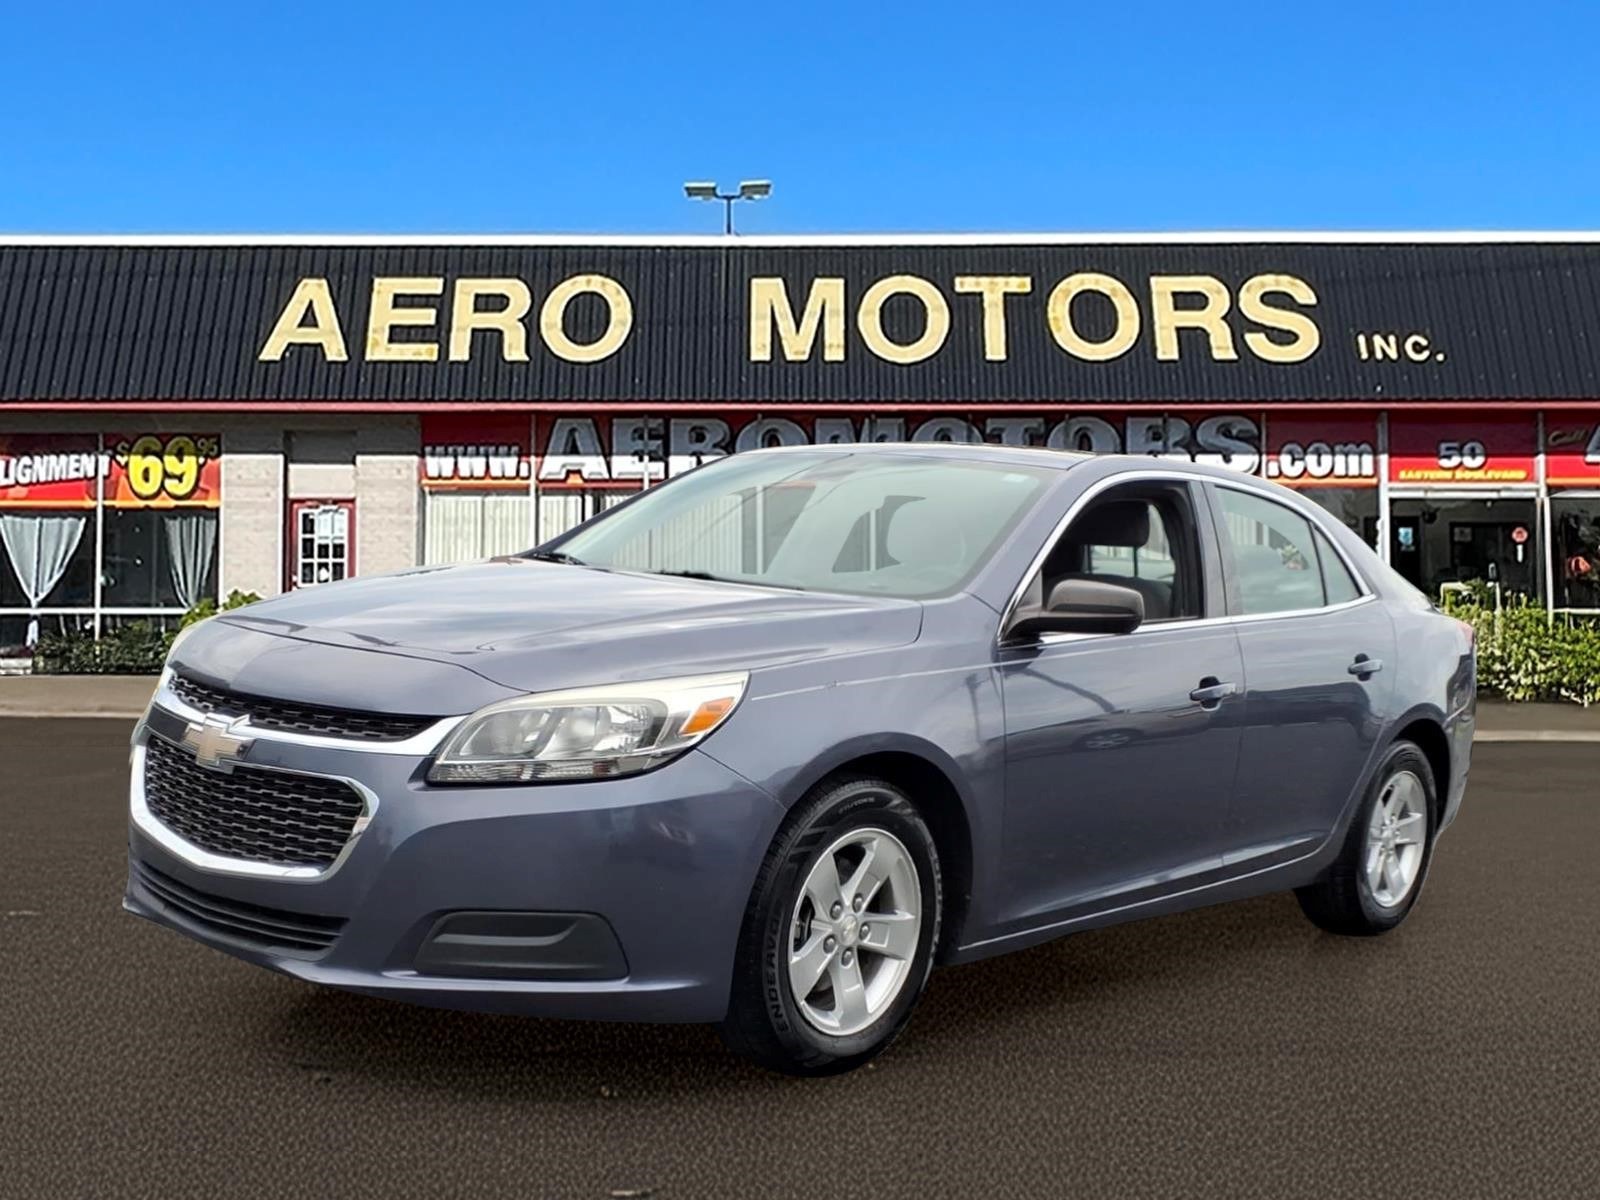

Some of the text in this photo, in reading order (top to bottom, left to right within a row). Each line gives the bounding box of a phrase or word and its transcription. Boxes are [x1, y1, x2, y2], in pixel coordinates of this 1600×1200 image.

[258, 273, 1445, 364] AERO MOTORS INC.
[1438, 441, 1486, 469] 50
